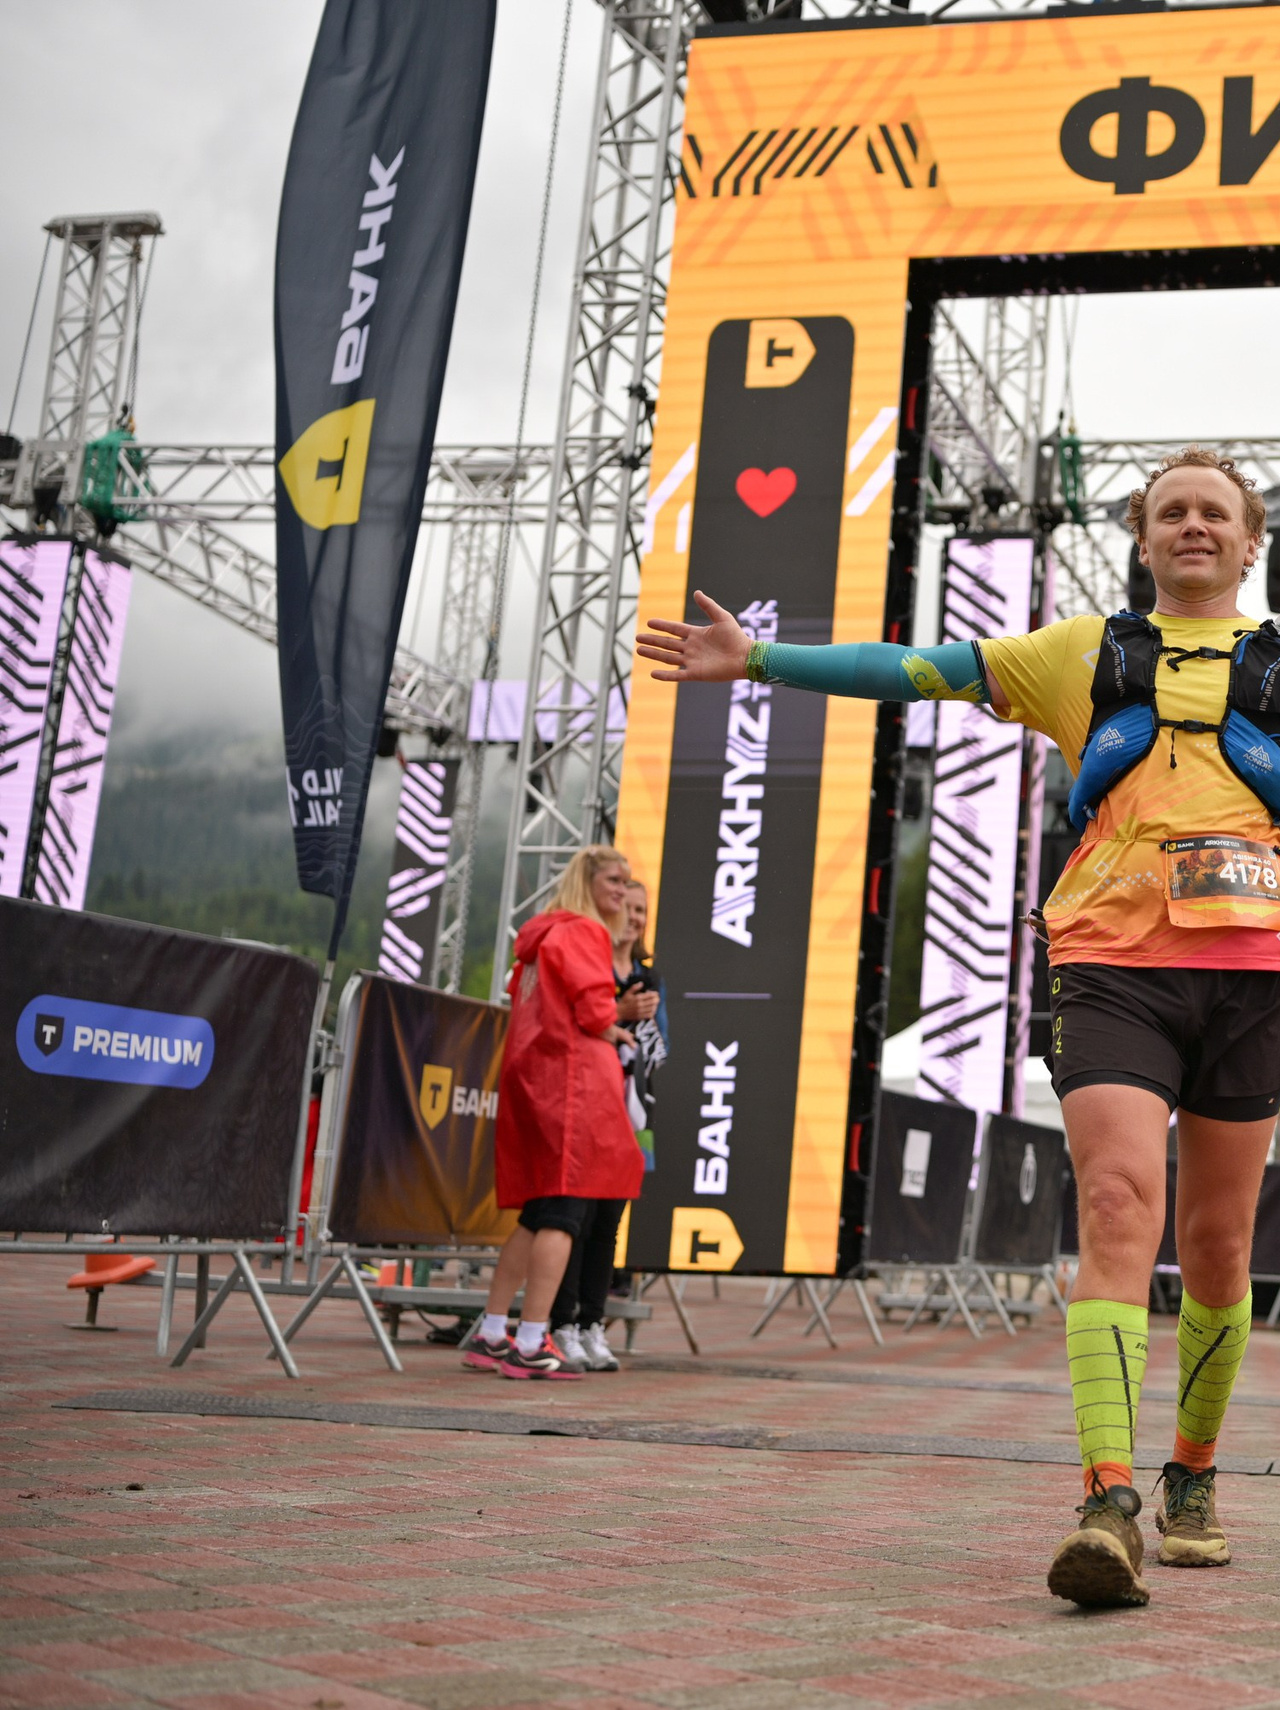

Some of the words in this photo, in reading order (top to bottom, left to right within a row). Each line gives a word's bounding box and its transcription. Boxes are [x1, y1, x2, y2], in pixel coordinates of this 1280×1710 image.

[711, 701, 771, 947] ARKHYZ
[1219, 861, 1278, 889] 4178
[72, 1025, 204, 1067] PREMIUM
[693, 1041, 739, 1195] БАНК
